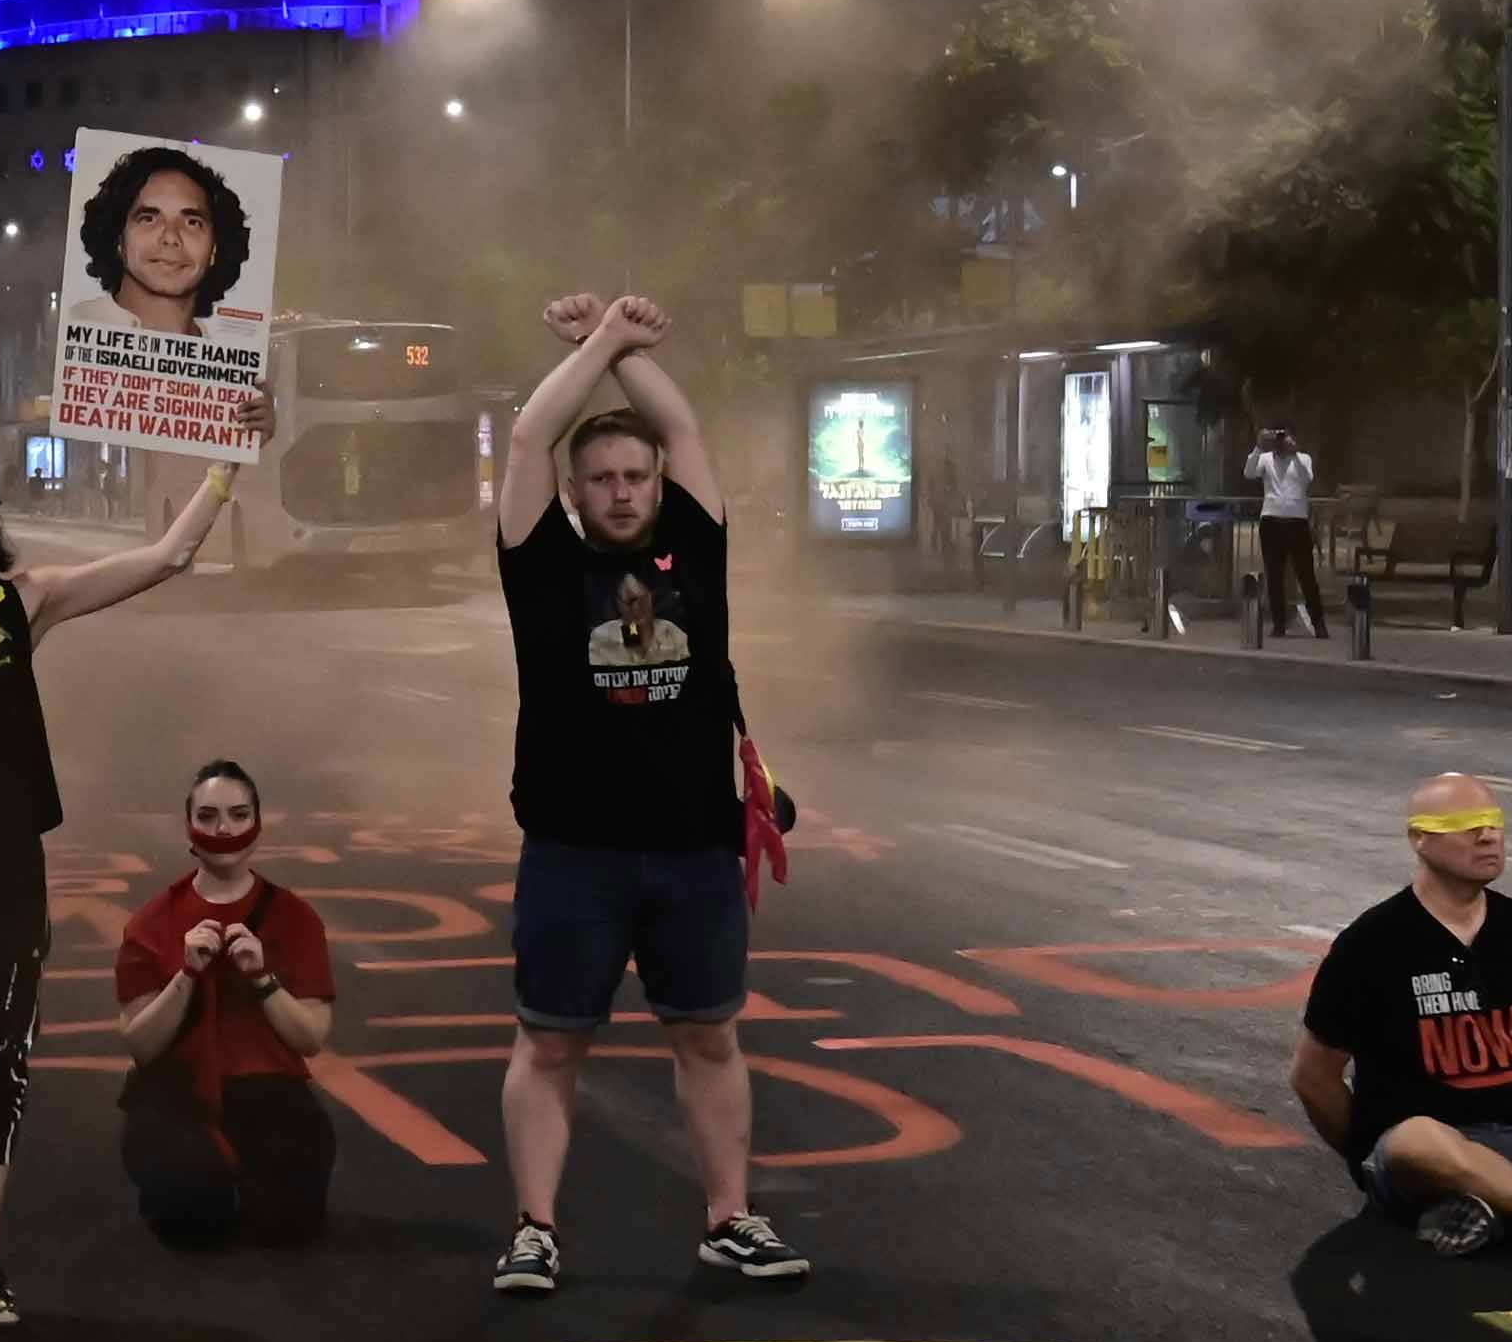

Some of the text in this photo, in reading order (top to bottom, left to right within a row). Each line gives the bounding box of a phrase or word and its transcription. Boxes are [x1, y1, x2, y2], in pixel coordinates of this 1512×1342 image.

[66, 325, 260, 368] MY LIFE IS IN THE HANDS
[405, 345, 430, 365] 532
[63, 365, 79, 381] IF
[80, 367, 119, 388] THEY
[121, 372, 165, 393] DON'T
[166, 380, 201, 399] SIGN
[203, 385, 214, 401] A
[64, 345, 259, 386] OF THE ISRAELI GOVERNMENT
[62, 383, 110, 407] THEY
[112, 392, 154, 412] ARE
[154, 396, 225, 422] SIGNING
[59, 403, 254, 449] DEATH WARRANT!
[632, 669, 649, 686] את
[1411, 972, 1452, 996] BRING
[1416, 992, 1452, 1016] THEM
